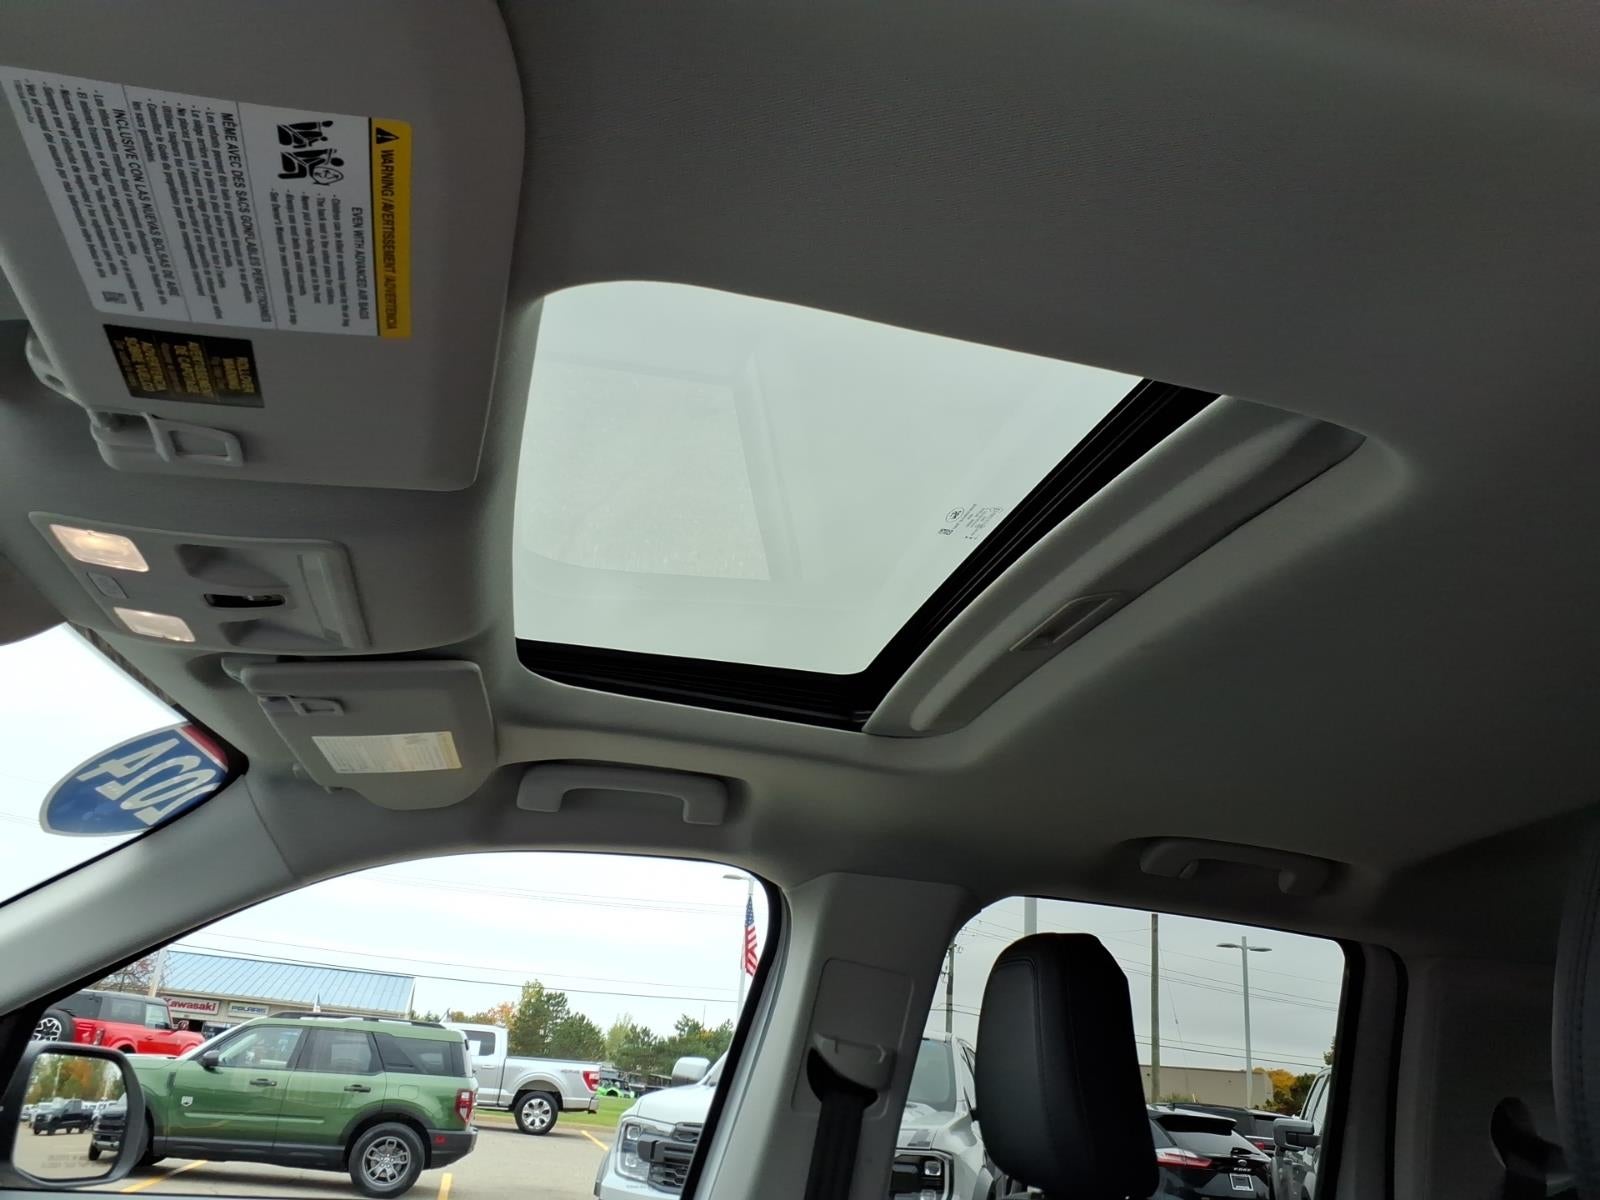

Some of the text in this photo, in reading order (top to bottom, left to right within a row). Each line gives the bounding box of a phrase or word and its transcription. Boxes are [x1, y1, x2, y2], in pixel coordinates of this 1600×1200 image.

[112, 109, 139, 160] INCLUSIVE
[220, 112, 241, 142] MÊME
[226, 143, 243, 168] AVEC
[127, 162, 145, 183] CON
[231, 170, 246, 189] DES
[381, 148, 394, 197] WARNING
[134, 184, 151, 202] LAS
[235, 190, 251, 214] SACS
[141, 203, 161, 236] NUEVAS
[351, 207, 364, 228] EVEN
[240, 215, 262, 267] GONFLABLES
[353, 230, 366, 249] WITH
[151, 237, 171, 268] BOLSAS
[161, 269, 175, 280] DE
[355, 250, 368, 288] ADVANCED
[166, 281, 180, 297] AIRE
[358, 289, 369, 300] AIR
